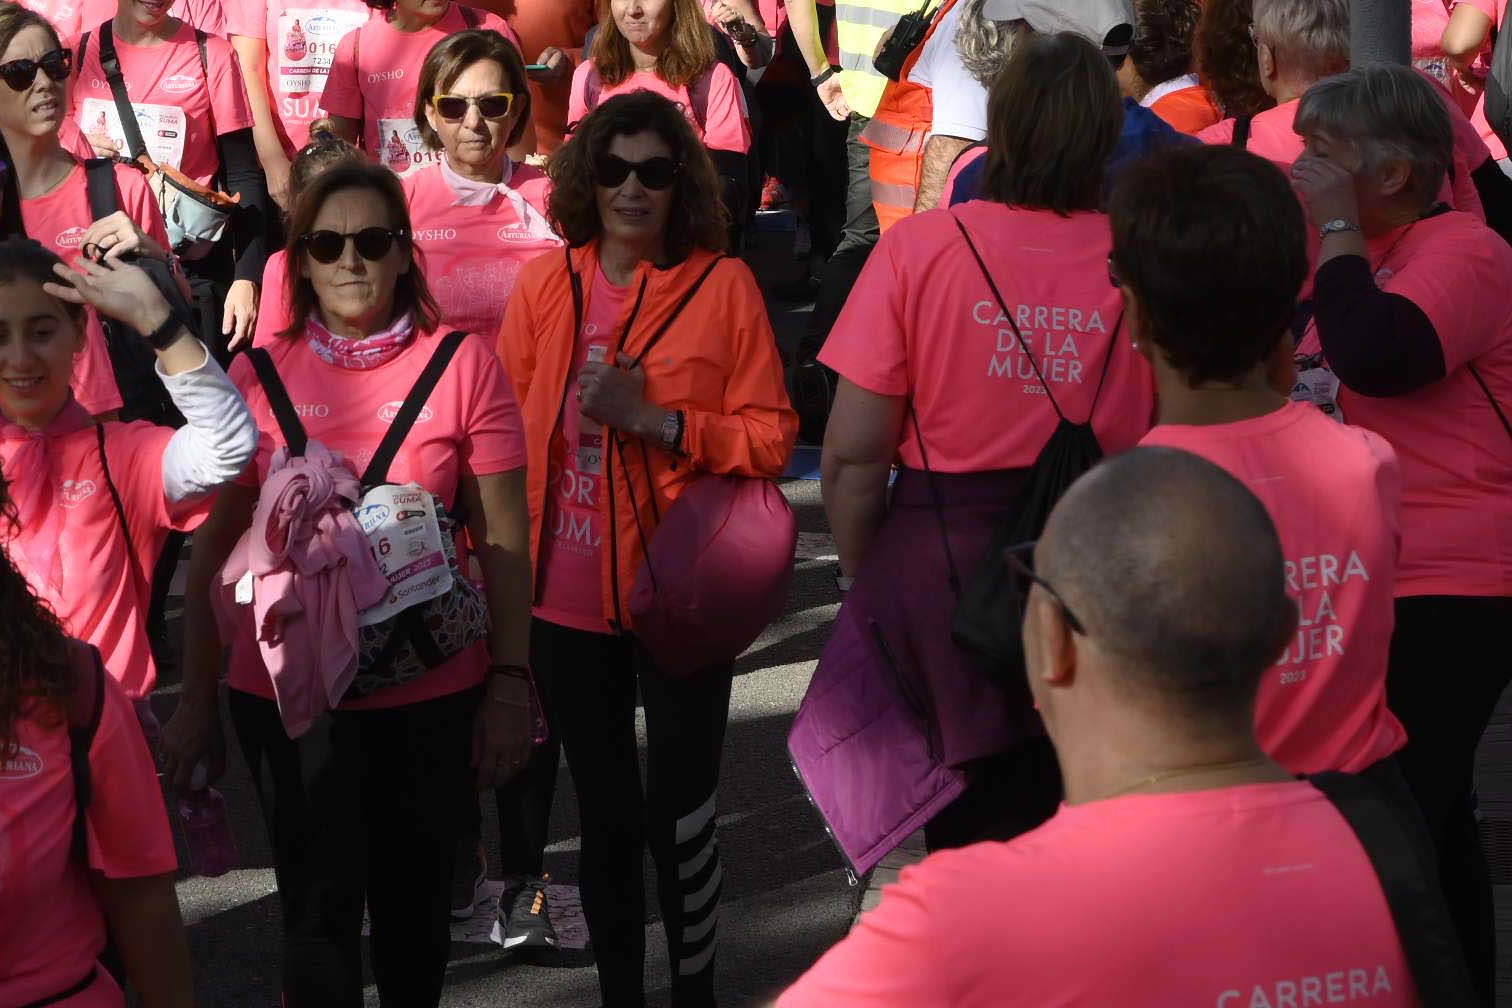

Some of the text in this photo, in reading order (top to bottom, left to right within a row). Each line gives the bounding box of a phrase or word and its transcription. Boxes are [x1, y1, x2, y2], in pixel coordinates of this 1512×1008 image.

[91, 78, 131, 93] OYO
[368, 68, 404, 83] OYSHO
[973, 301, 1106, 334] CARRERA
[995, 329, 1080, 360] DE LA
[987, 355, 1083, 383] MUJER
[390, 568, 411, 583] UJER
[398, 575, 441, 597] Santander
[1299, 591, 1337, 627] LA
